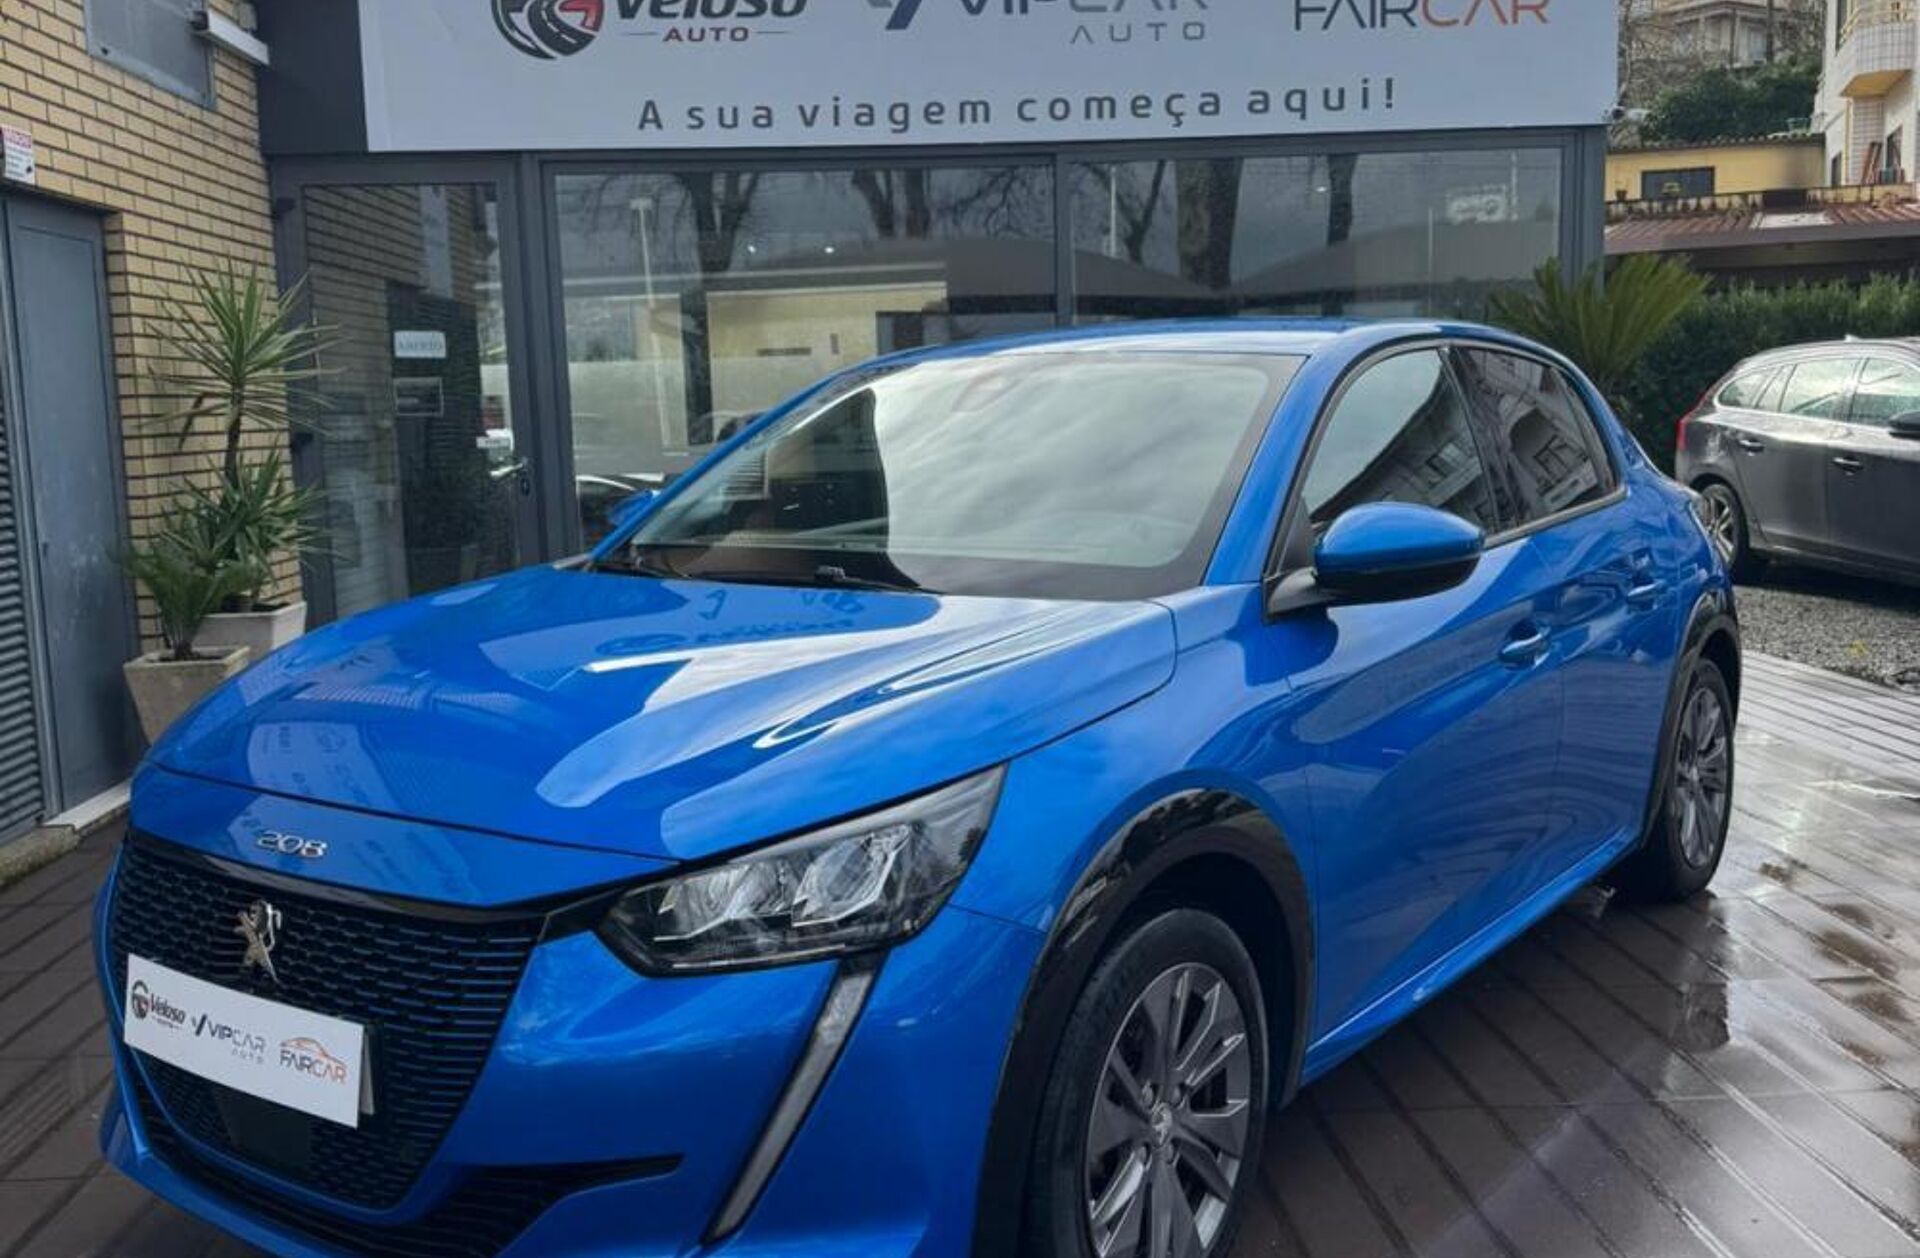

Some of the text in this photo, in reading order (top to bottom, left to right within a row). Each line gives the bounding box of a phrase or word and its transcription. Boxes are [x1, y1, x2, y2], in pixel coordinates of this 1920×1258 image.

[1294, 0, 1549, 31] FAIRCAR
[662, 26, 750, 42] AUTO
[1069, 21, 1206, 44] AUTO
[638, 77, 1394, 134] A sua viagem começa aqui!
[257, 830, 328, 858] 208
